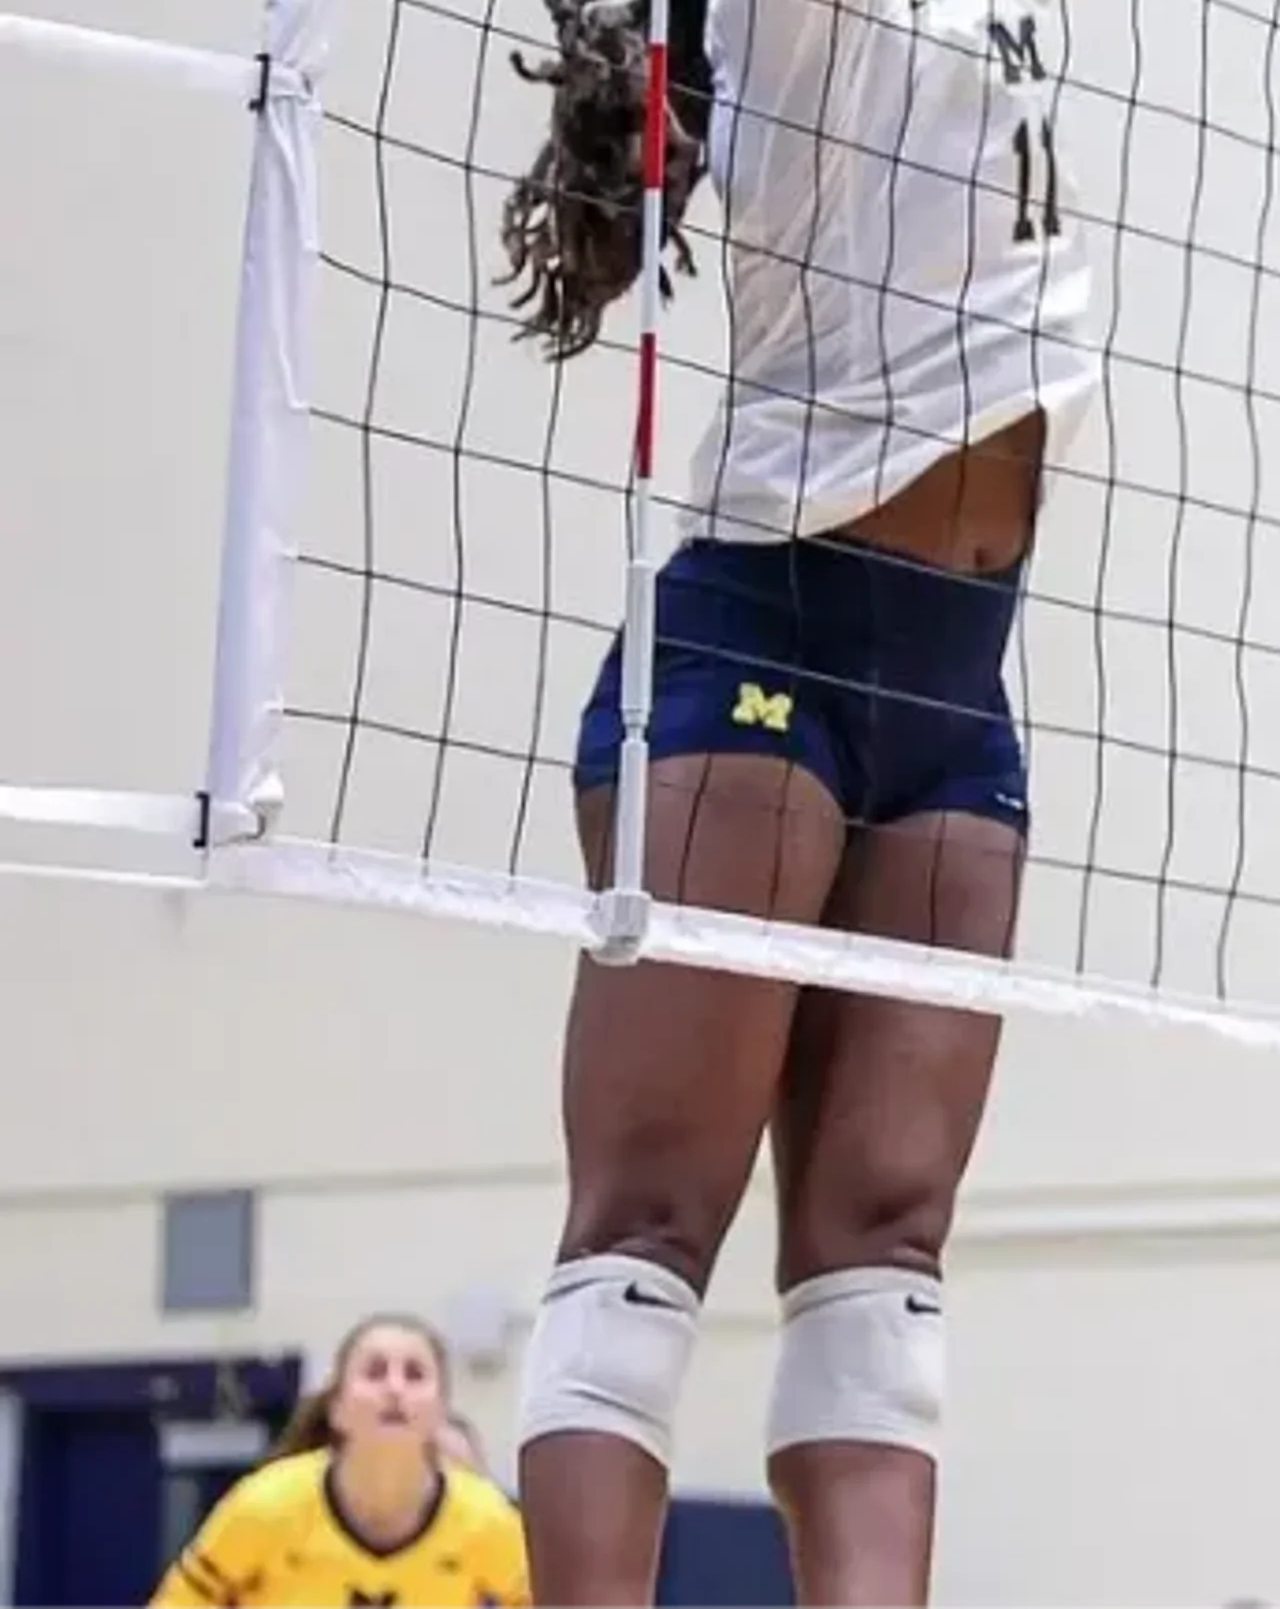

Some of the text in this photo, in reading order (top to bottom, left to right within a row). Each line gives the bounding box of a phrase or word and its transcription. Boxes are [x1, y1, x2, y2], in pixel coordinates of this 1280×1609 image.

[987, 16, 1047, 83] M
[1012, 117, 1061, 243] 11
[732, 681, 794, 734] M
